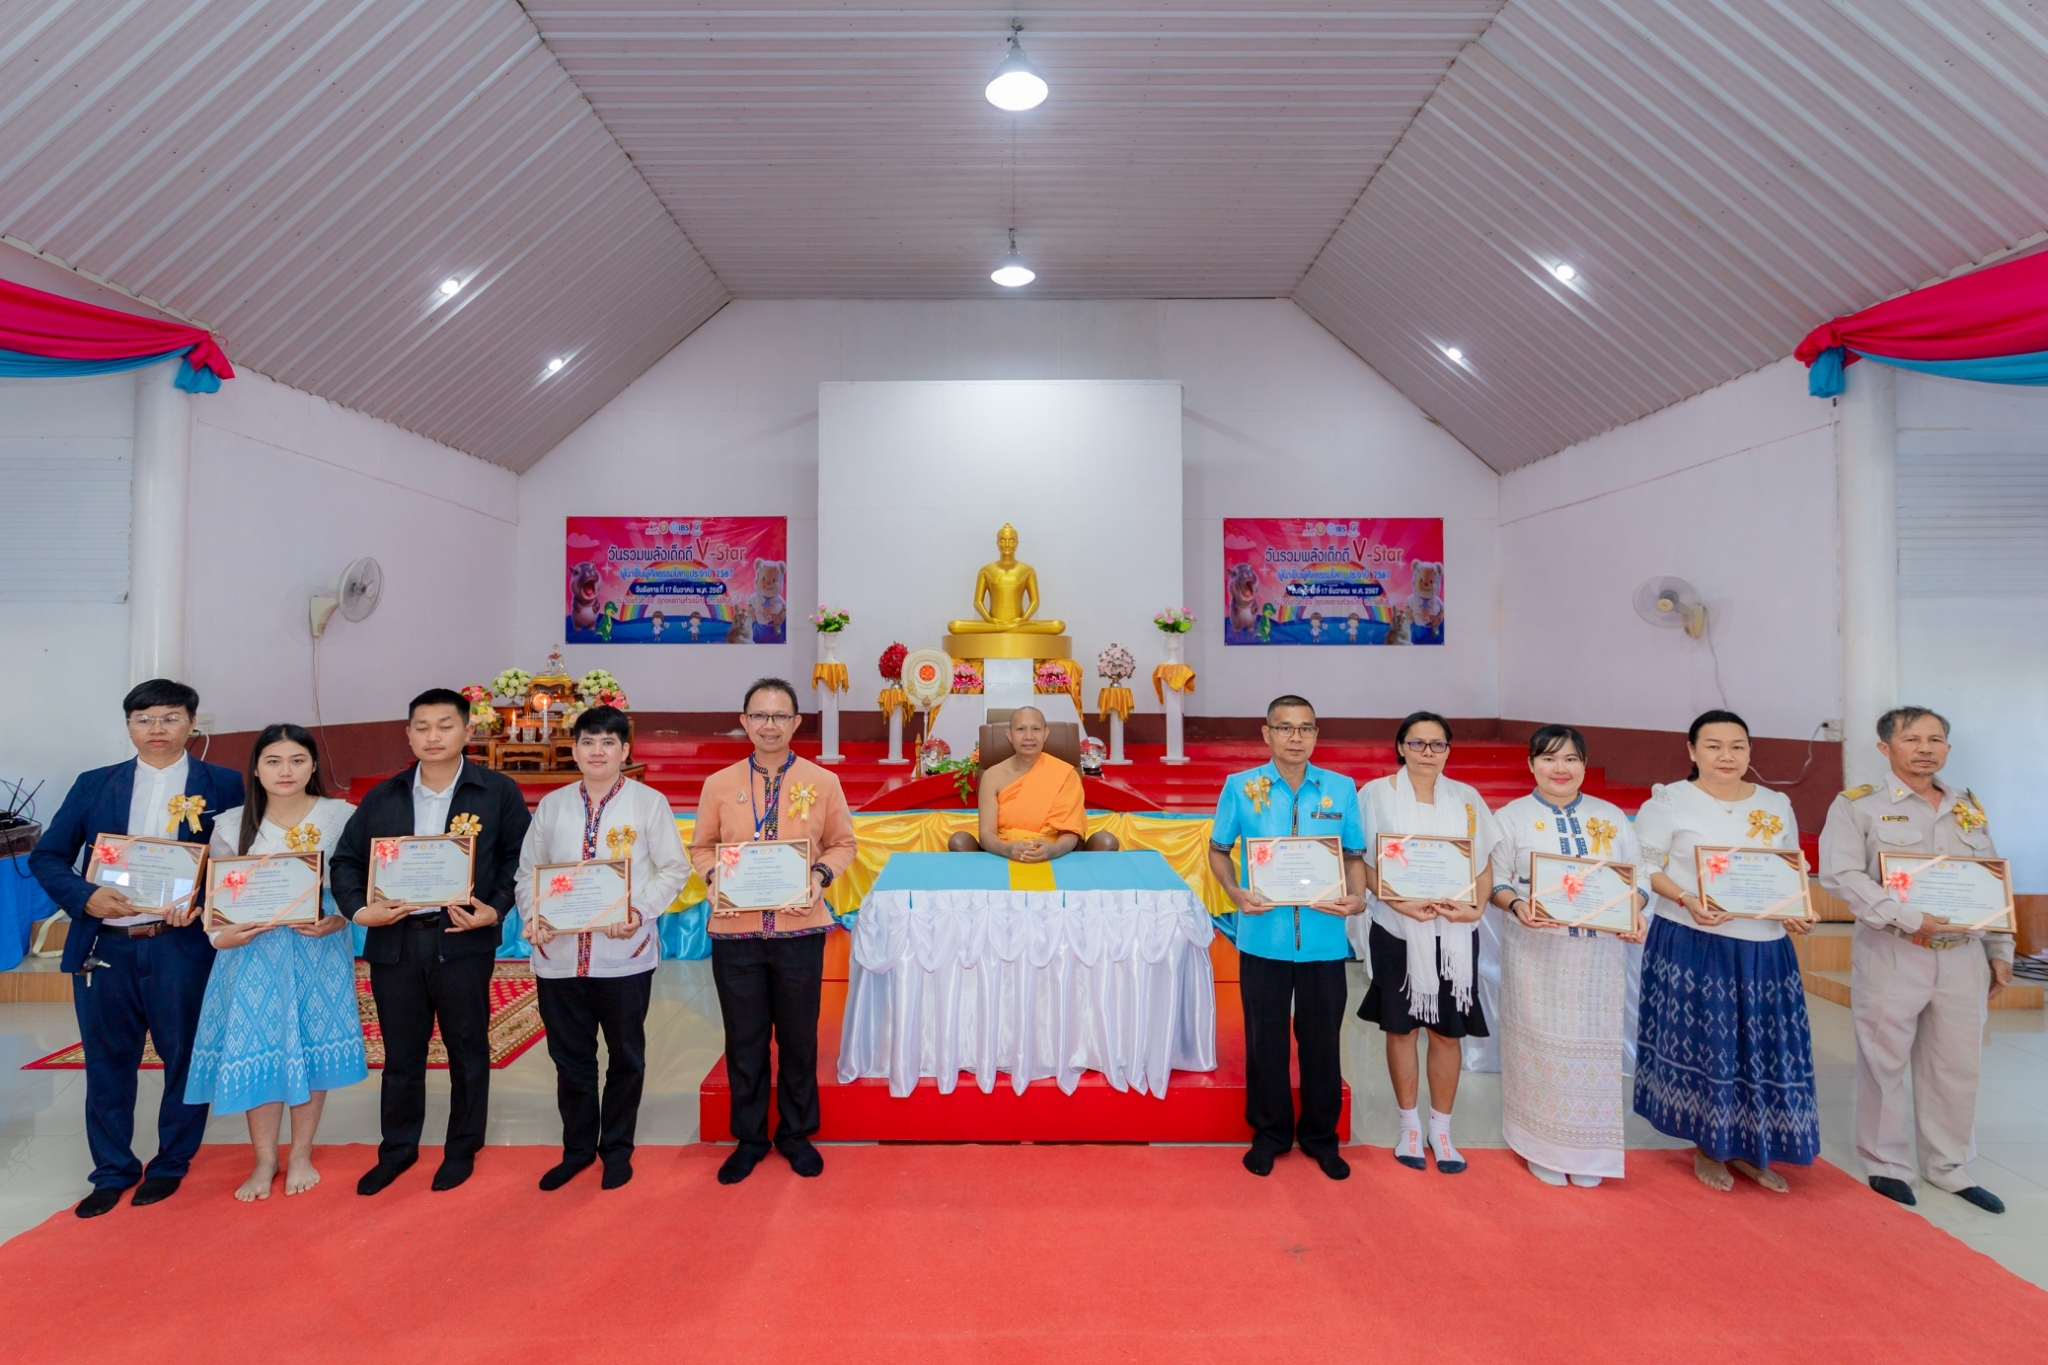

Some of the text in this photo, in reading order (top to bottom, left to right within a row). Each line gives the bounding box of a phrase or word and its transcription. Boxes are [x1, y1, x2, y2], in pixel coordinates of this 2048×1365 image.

[608, 538, 746, 561] วันรวมพลังเด็กดี V-Star
[1265, 539, 1403, 562] วันรวมพลังเด็กดี V-Star
[690, 567, 712, 578] ประจำปี
[716, 569, 733, 578] 2567
[1346, 568, 1370, 579] ประจำปี
[1373, 571, 1390, 579] 2567
[672, 585, 695, 593] ธันวาคม
[1328, 586, 1350, 594] ธันวาคม
